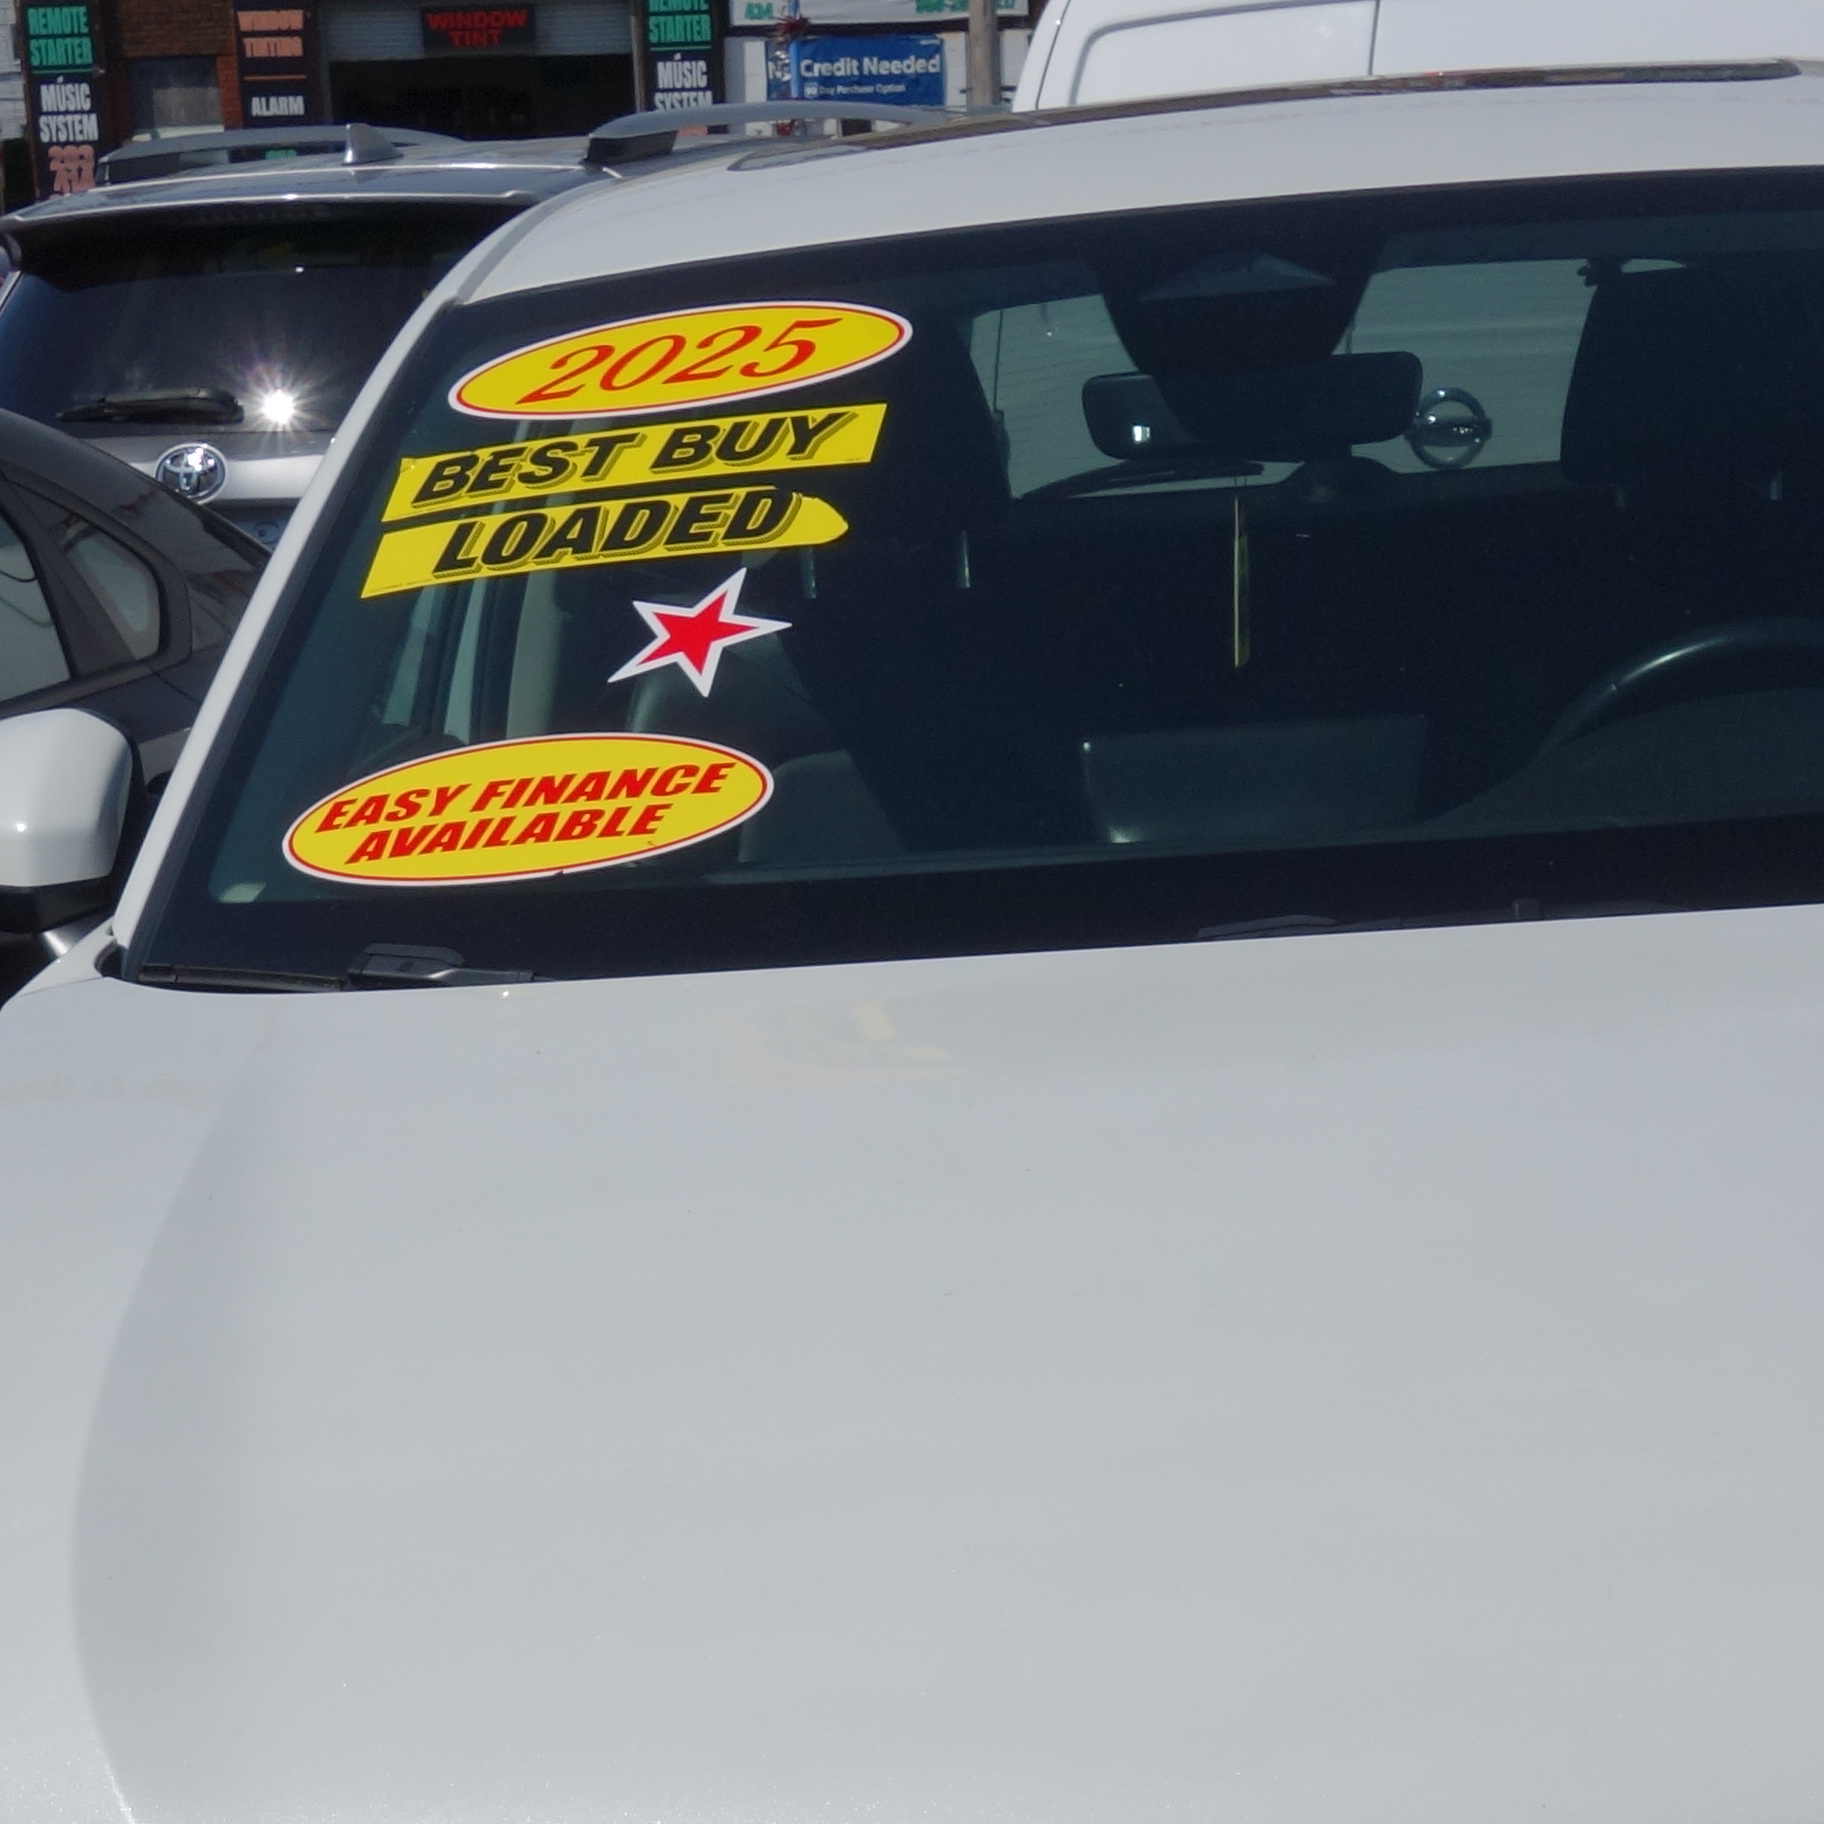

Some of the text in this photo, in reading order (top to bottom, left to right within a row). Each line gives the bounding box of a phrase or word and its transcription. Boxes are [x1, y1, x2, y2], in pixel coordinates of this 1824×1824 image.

[28, 6, 88, 35] REMOTE
[428, 10, 526, 29] WINDOW
[649, 14, 712, 43] STARTER
[29, 36, 94, 66] STARTER
[449, 30, 503, 46] TINT
[800, 57, 859, 78] Credit
[863, 54, 941, 77] Needed
[252, 95, 305, 117] ALARM
[39, 113, 99, 143] SYSTEM
[516, 316, 844, 405] 2025
[412, 411, 859, 508] BEST BUY
[432, 491, 802, 578] LOADED
[317, 761, 736, 834] EASY FINANCE
[345, 803, 674, 864] AVAILABLE
